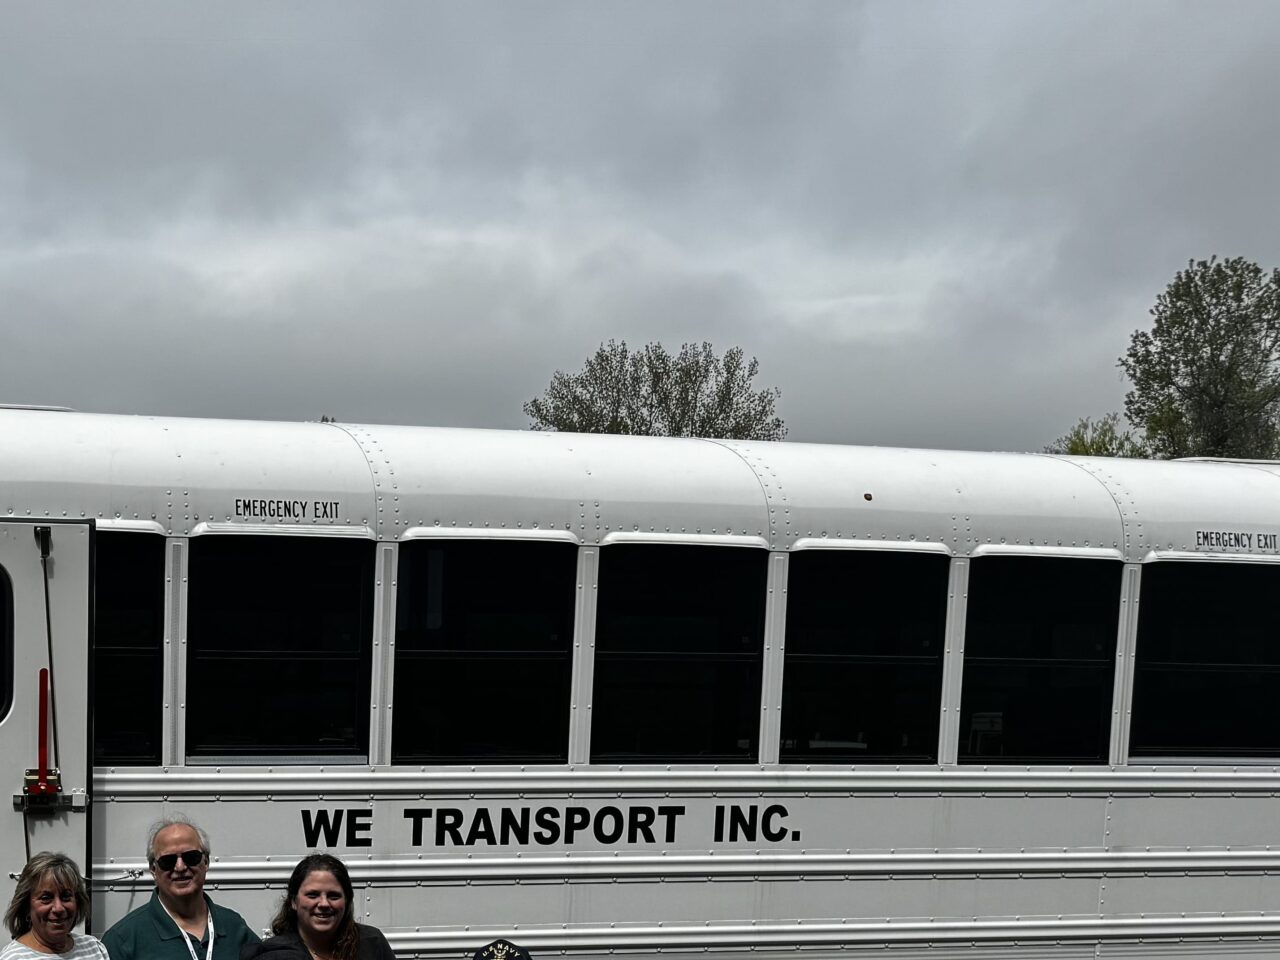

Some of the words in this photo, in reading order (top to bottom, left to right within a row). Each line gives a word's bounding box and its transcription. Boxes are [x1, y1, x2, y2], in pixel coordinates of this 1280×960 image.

[235, 499, 308, 518] EMERGENCY
[314, 501, 340, 519] EXIT
[1196, 531, 1253, 549] EMERGENCY
[1257, 534, 1277, 549] EXIT
[300, 809, 373, 848] WE
[403, 805, 686, 847] TRANSPORT
[713, 804, 801, 843] INC.
[497, 943, 521, 957] NAVY
